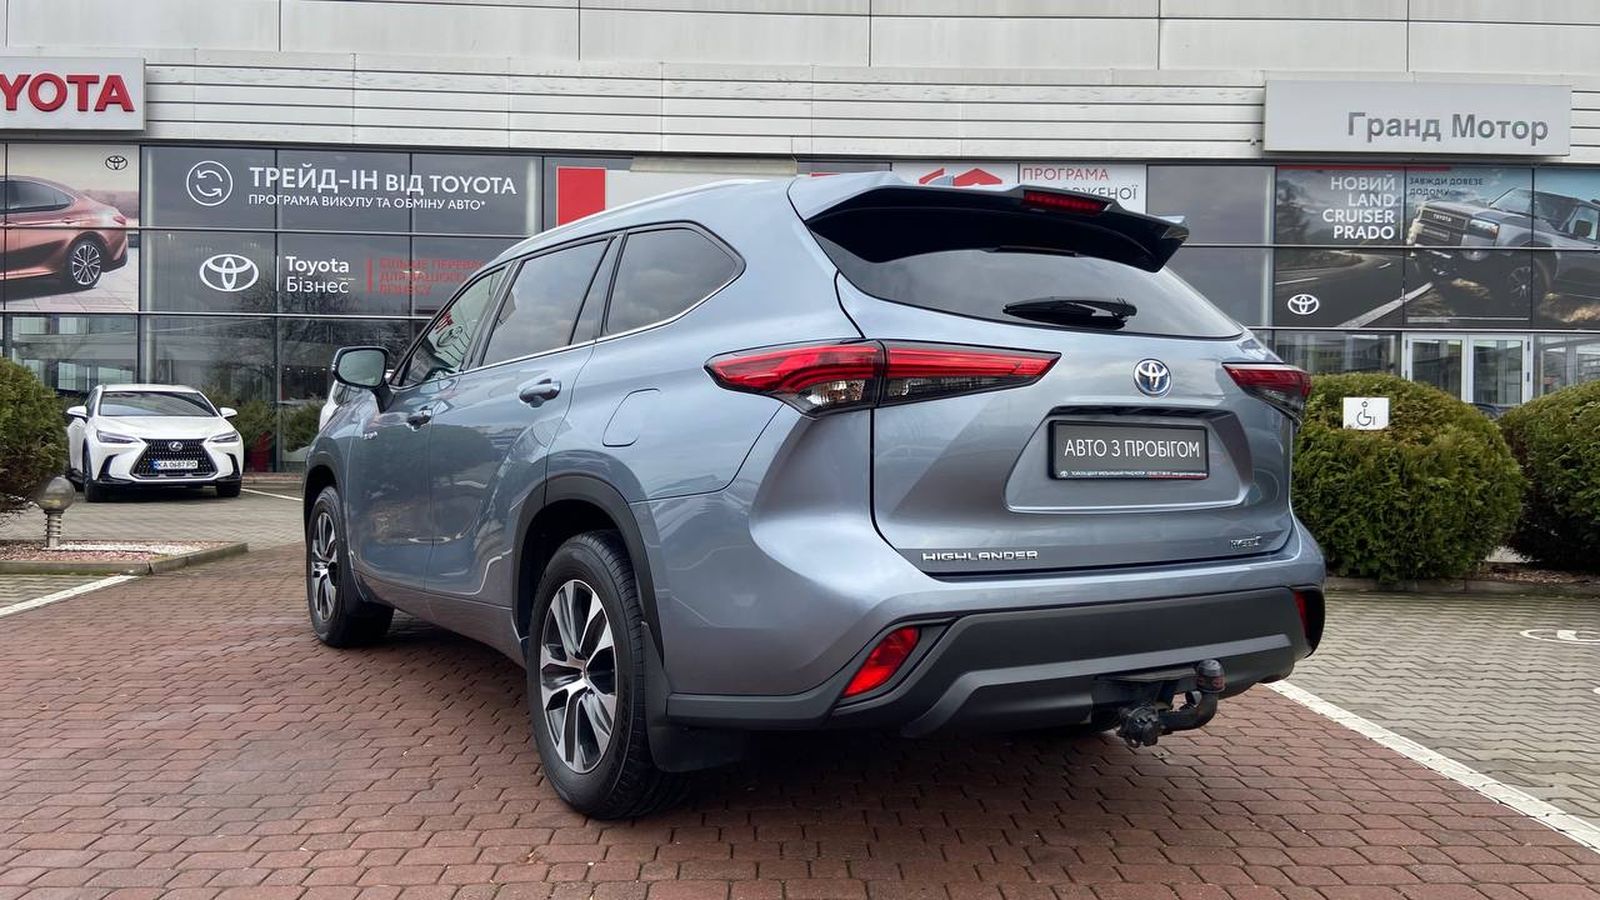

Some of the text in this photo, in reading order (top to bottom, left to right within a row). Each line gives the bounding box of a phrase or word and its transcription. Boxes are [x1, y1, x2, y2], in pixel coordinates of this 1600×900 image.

[1348, 112, 1549, 146] Гранд Мотор
[249, 163, 517, 196] ТРЕЙД-ІН ВІД TOYOTA
[1022, 167, 1110, 181] ПРОГРАМА
[1330, 174, 1396, 191] НОВИЙ
[248, 194, 319, 206] ПРОГРАМА
[321, 196, 373, 207] ВИКУПУ
[375, 198, 391, 208] ТА
[393, 198, 446, 209] ОБМІНУ
[1348, 192, 1396, 207] LAND
[1322, 208, 1395, 224] CRUISER
[1333, 225, 1395, 240] PRADO
[285, 256, 350, 275] Toyota
[286, 276, 349, 293] Бізнес
[1064, 439, 1107, 457] АВТО
[1124, 440, 1200, 458] ПРОБІГОМ
[922, 550, 1039, 561] HIGHLANDER
